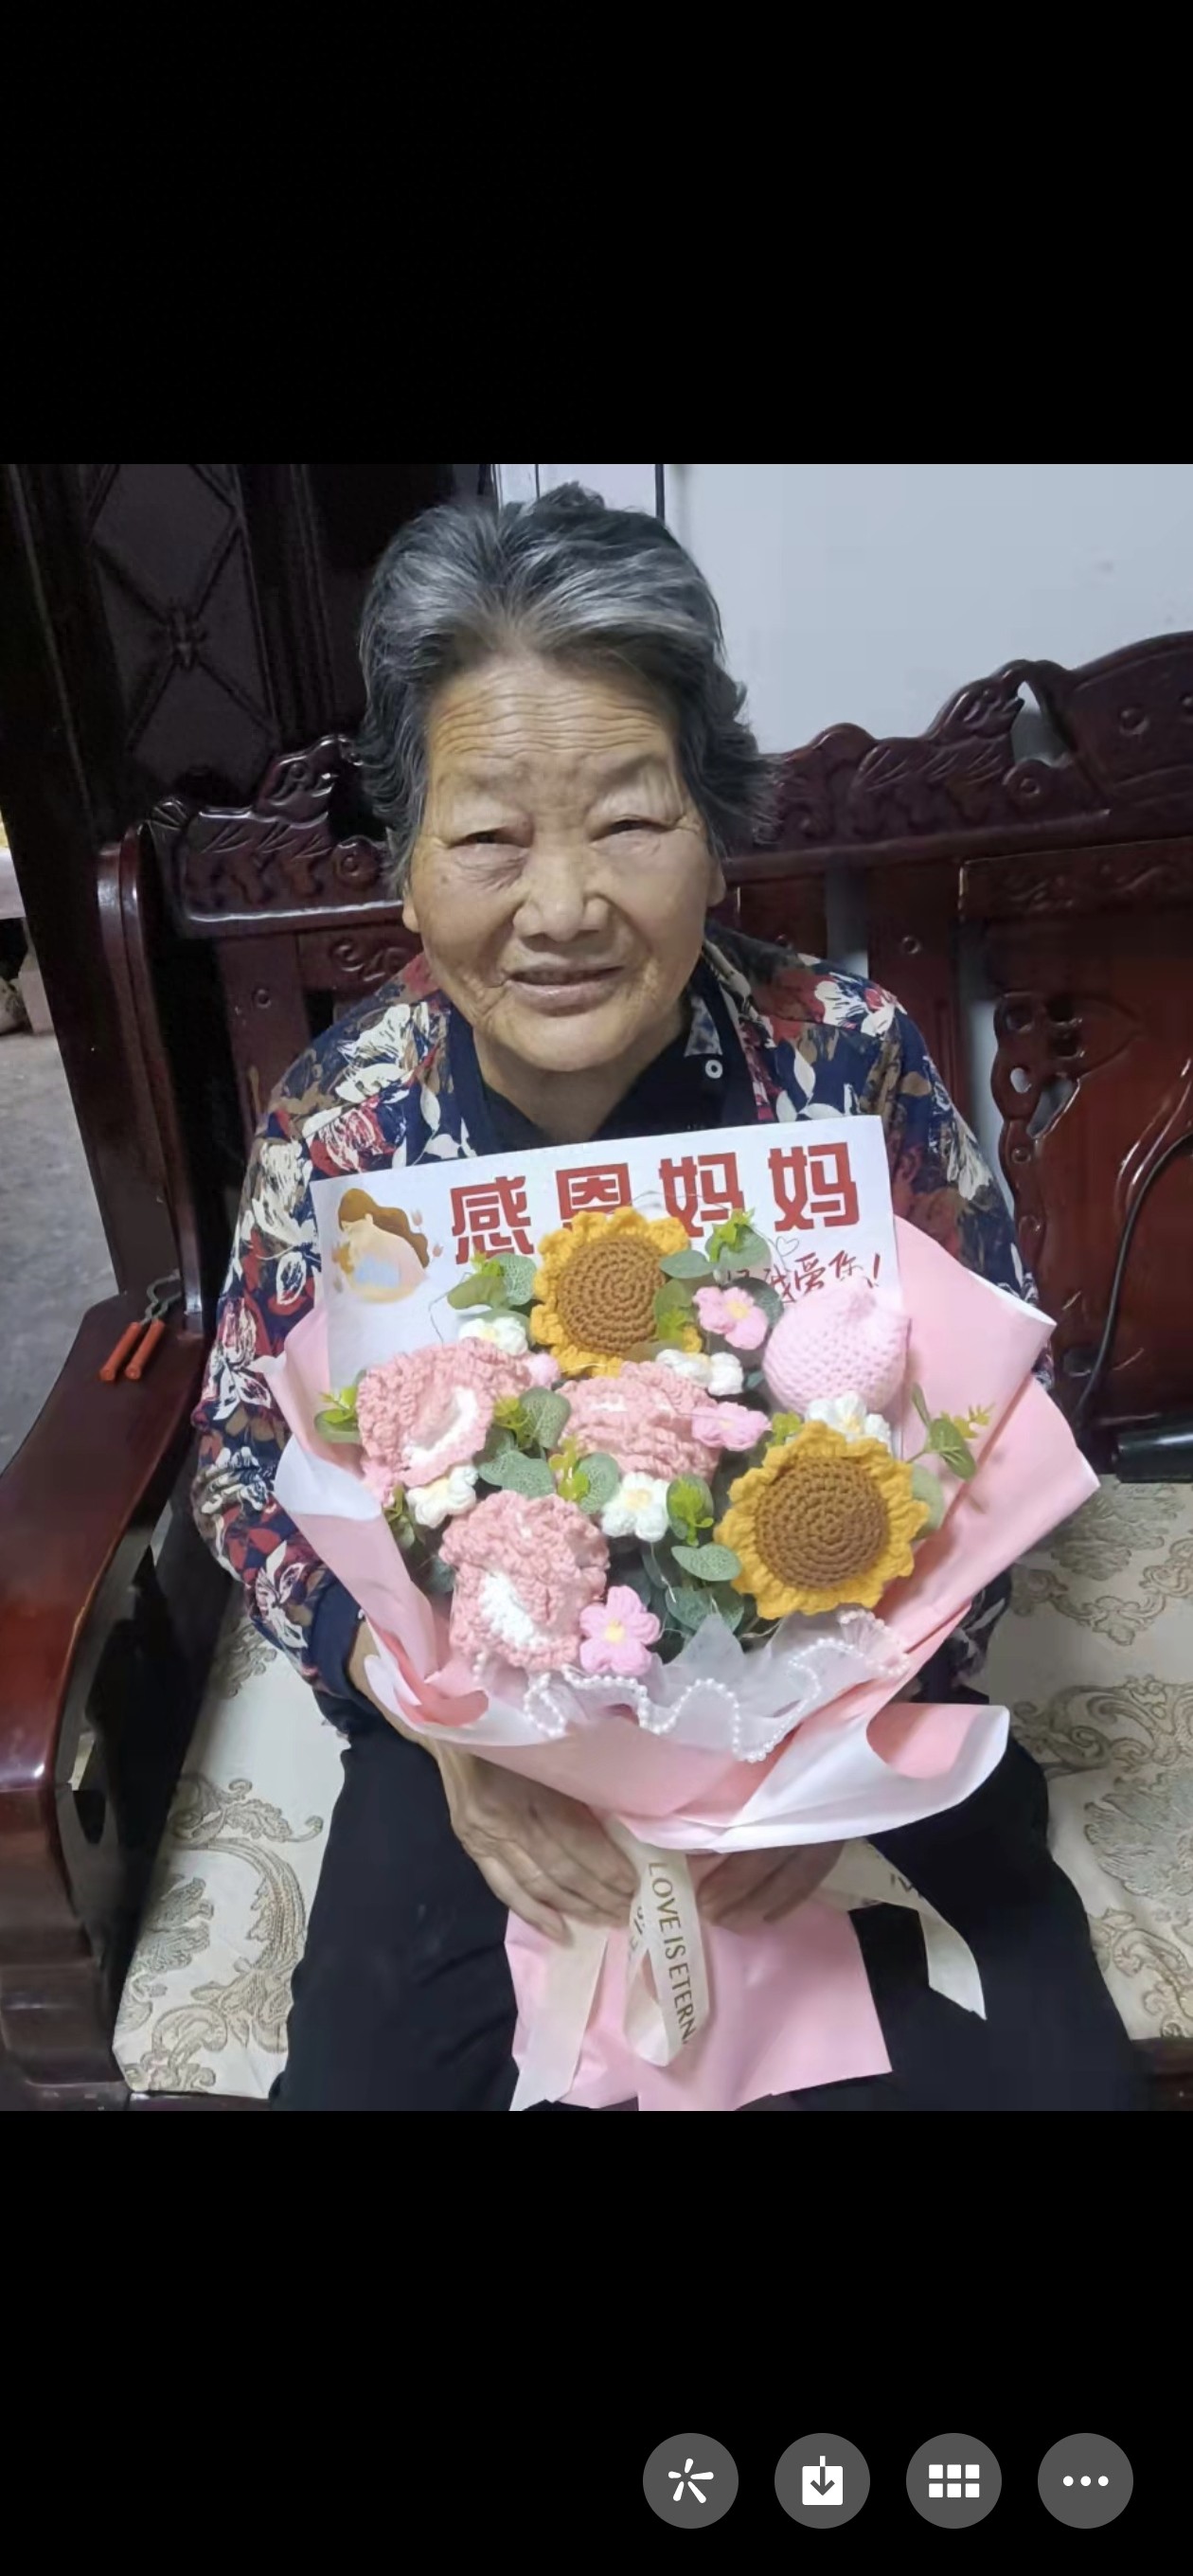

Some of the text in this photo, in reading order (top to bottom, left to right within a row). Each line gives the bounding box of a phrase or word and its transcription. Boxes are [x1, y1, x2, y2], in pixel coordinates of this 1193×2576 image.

[450, 1142, 860, 1264] 感恩妈妈
[648, 1862, 697, 2045] LOVE IS ETERN
